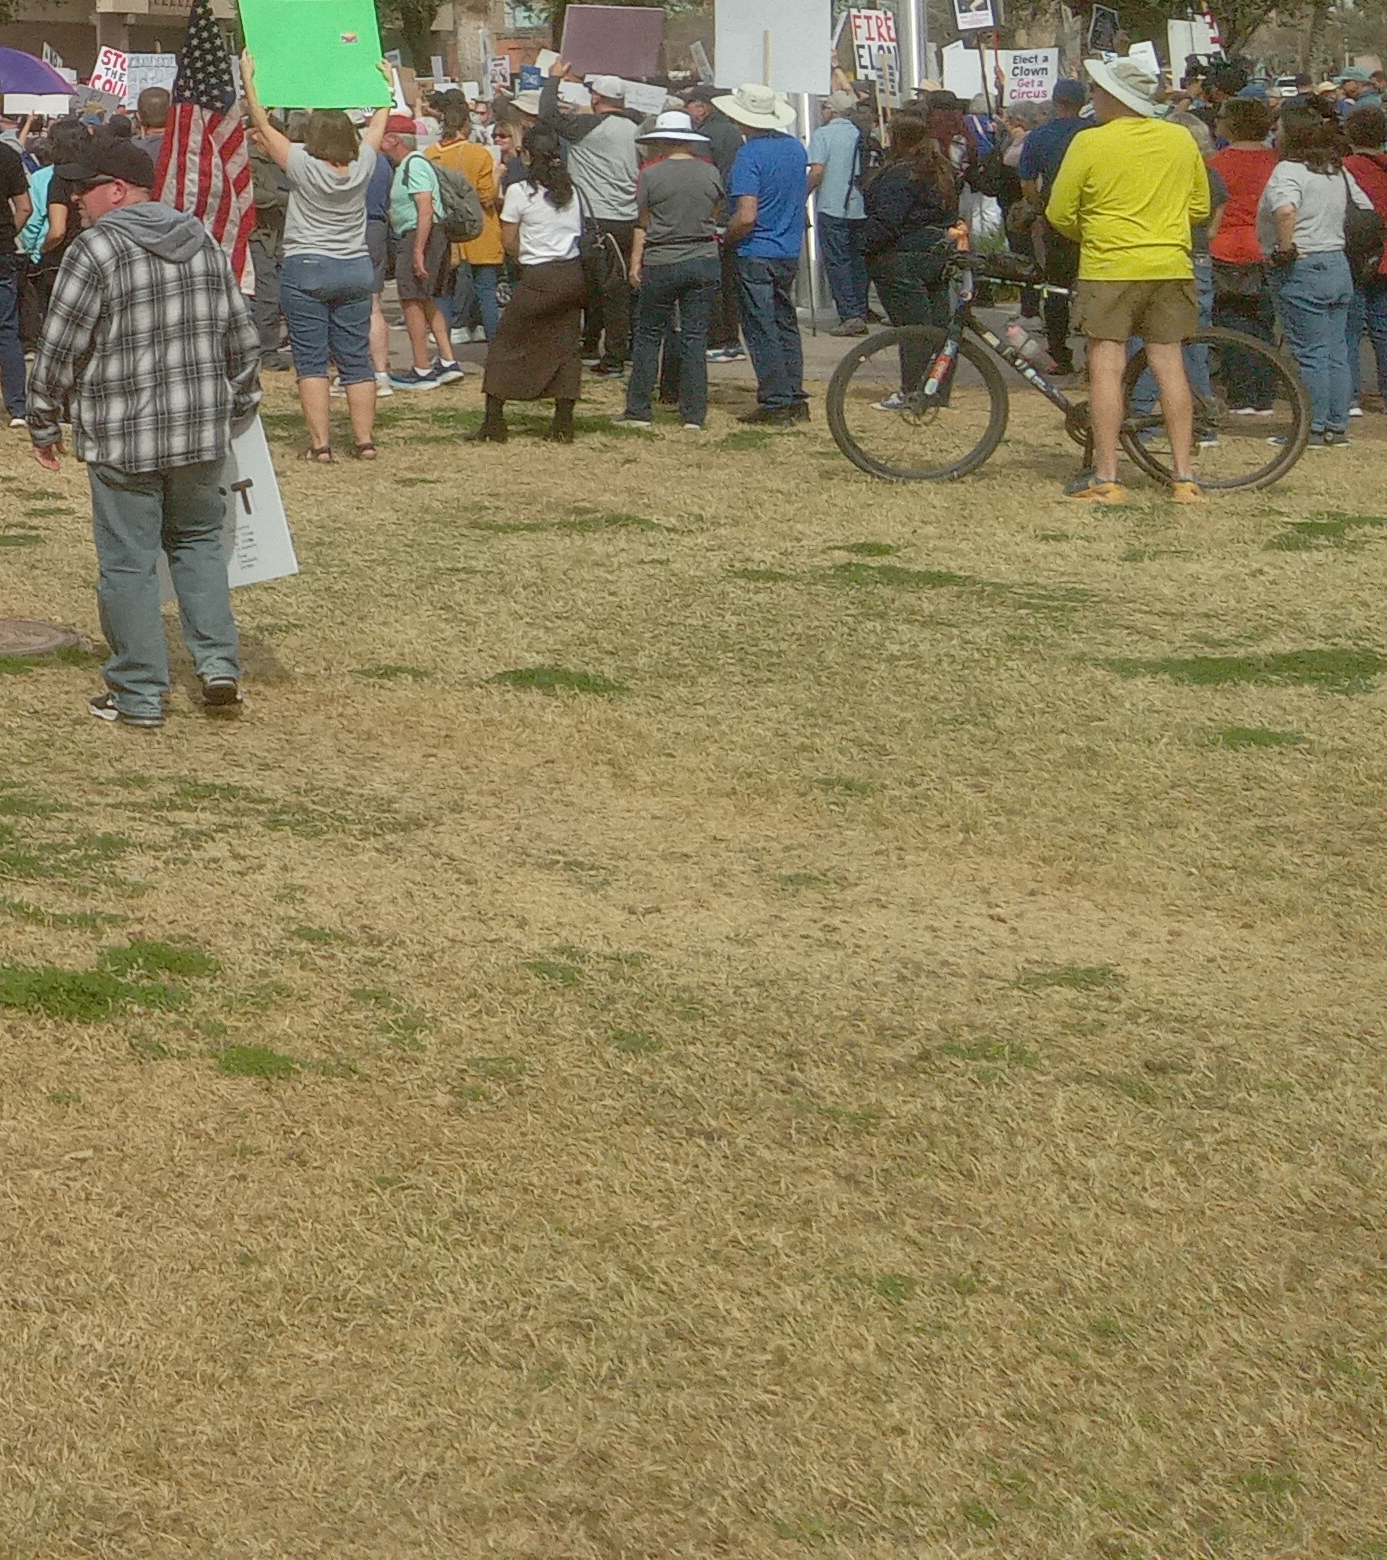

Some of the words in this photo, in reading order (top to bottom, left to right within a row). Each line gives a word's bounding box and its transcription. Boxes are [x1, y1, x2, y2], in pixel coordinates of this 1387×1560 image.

[852, 14, 896, 43] FIRE
[1013, 54, 1038, 64] Elect
[104, 67, 127, 82] THE
[1012, 66, 1048, 77] Clown
[1017, 78, 1034, 88] Get
[1009, 88, 1048, 100] Circus
